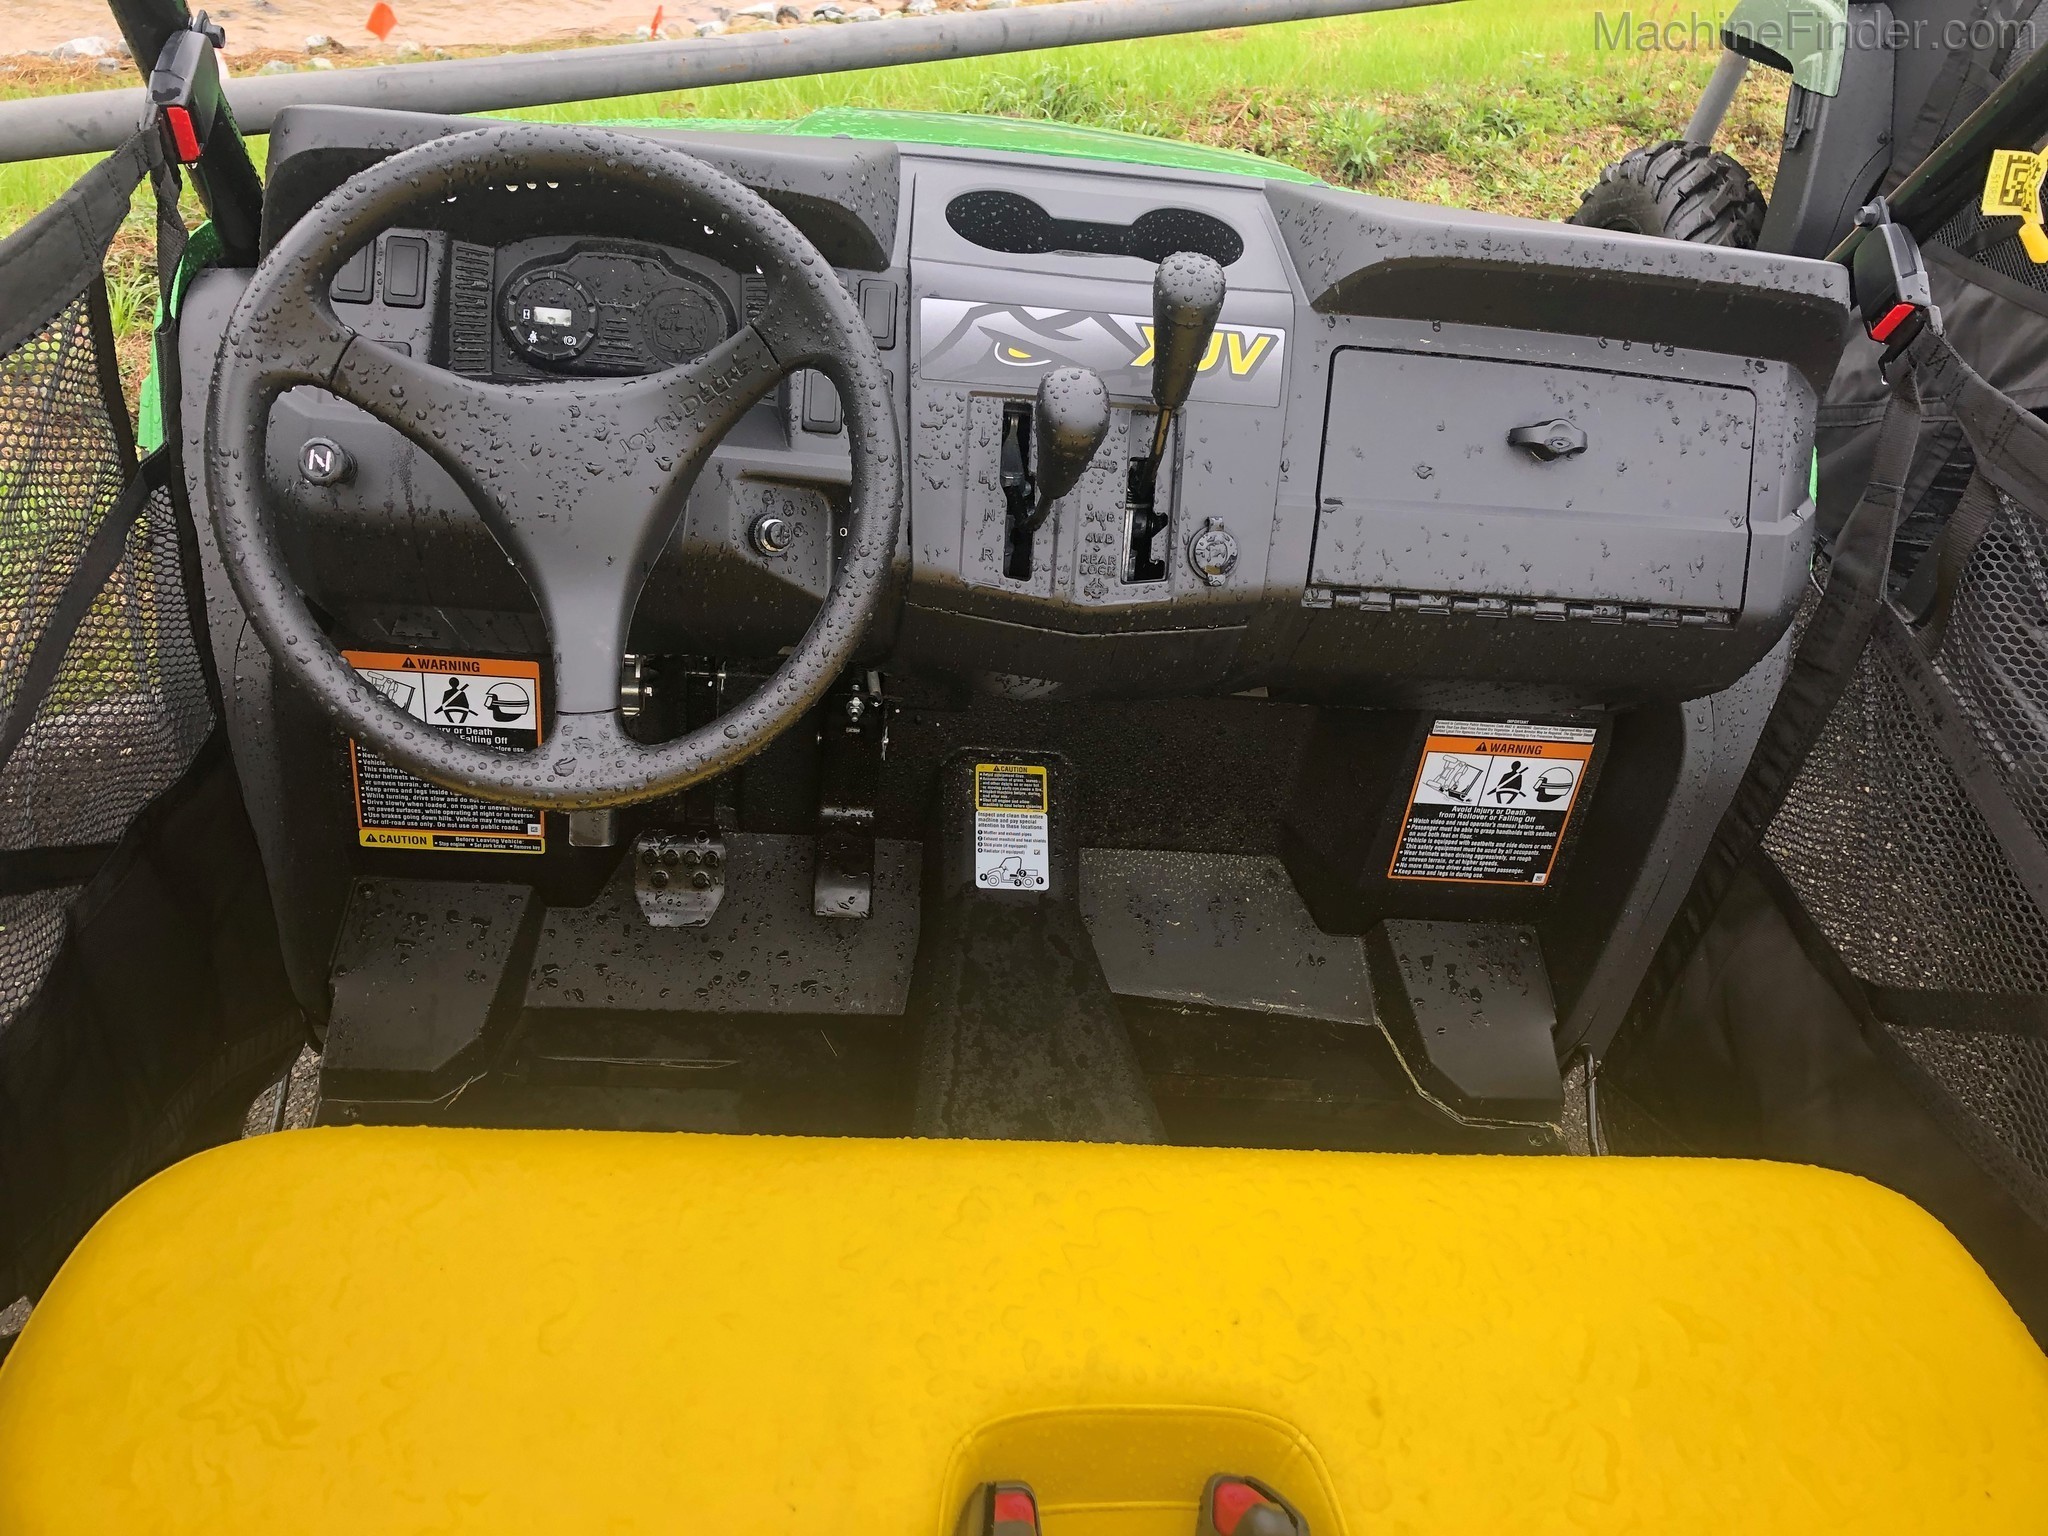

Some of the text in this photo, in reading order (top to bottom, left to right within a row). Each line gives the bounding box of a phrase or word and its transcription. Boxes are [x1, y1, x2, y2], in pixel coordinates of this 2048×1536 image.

[1080, 553, 1117, 566] REAR
[1079, 565, 1117, 577] LOCK
[418, 658, 480, 673] WARNING
[1490, 743, 1543, 755] WARNING
[1473, 807, 1495, 815] Injury
[1498, 815, 1524, 823] Falling
[379, 834, 428, 846] CAUTION
